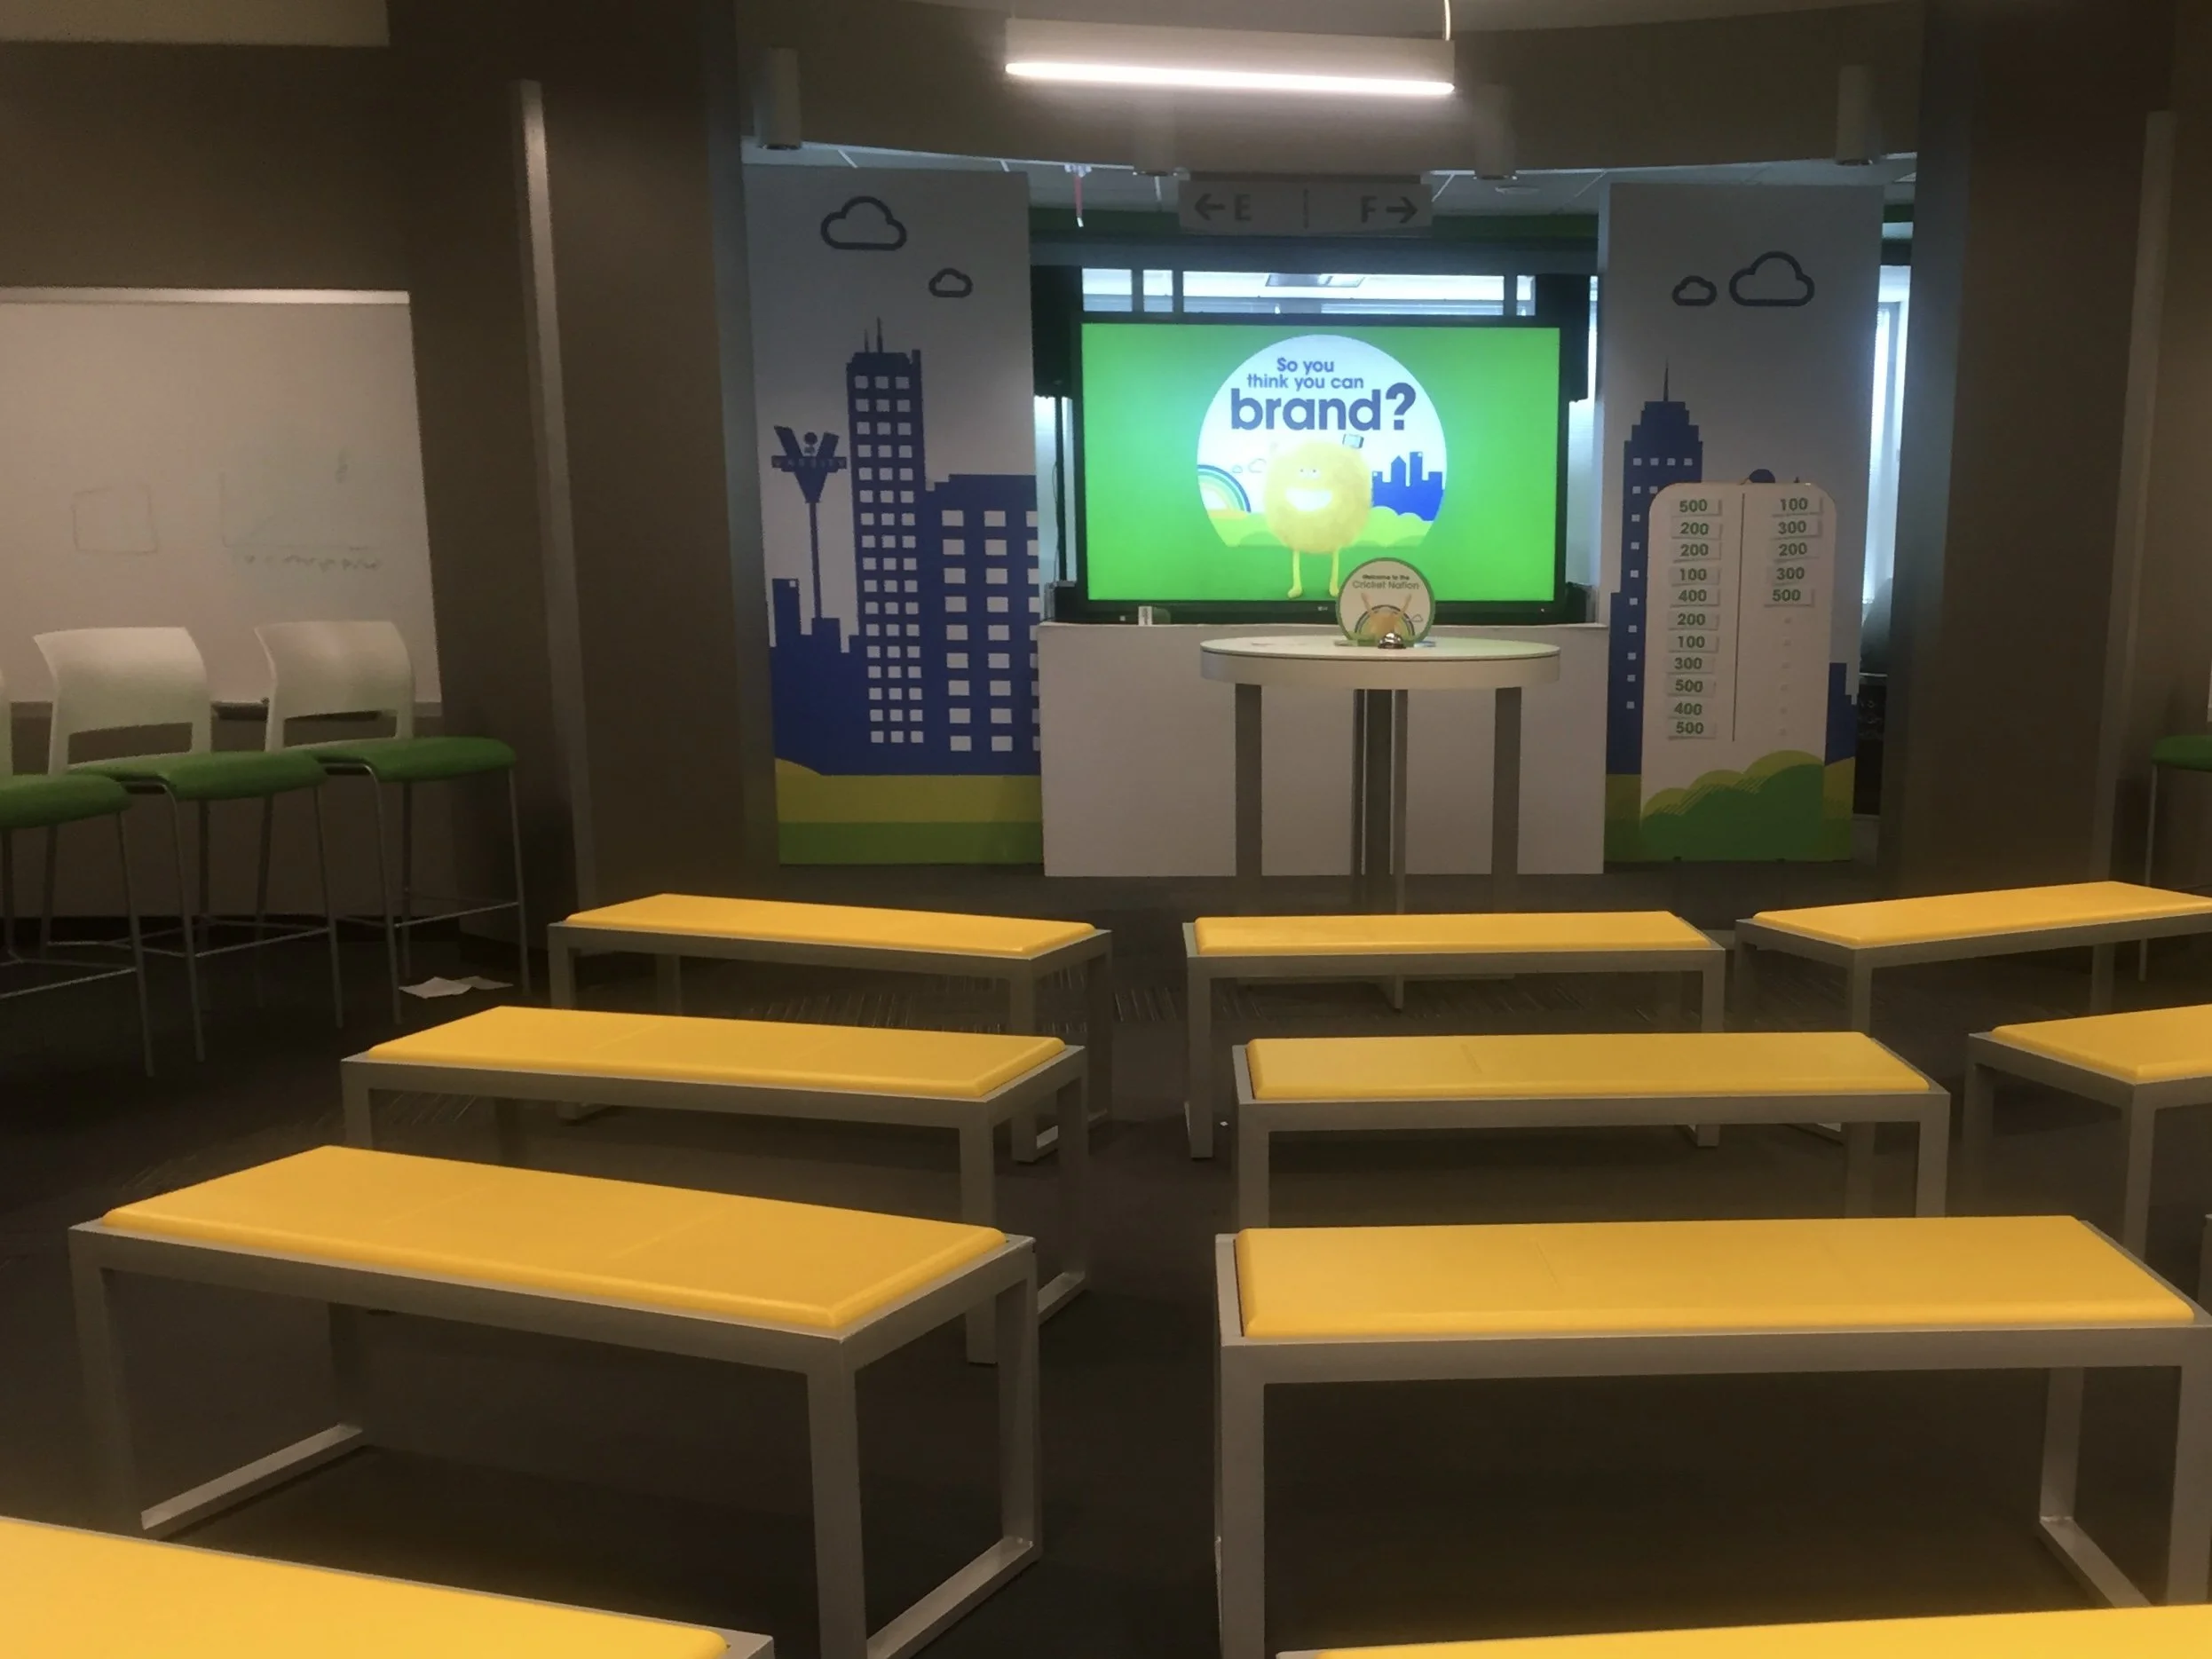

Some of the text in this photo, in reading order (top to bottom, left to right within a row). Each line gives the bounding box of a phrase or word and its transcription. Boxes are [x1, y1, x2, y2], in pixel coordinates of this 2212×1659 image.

[1234, 194, 1252, 222] E
[1360, 195, 1378, 223] F
[1276, 357, 1334, 375] So you
[1247, 374, 1364, 391] think you can
[1230, 382, 1417, 431] brand?
[1679, 499, 1708, 512] 500
[1780, 498, 1808, 510] 100
[1680, 522, 1709, 535] 200
[1778, 521, 1806, 534] 300
[1680, 543, 1709, 557] 200
[1779, 542, 1807, 557] 200
[1679, 568, 1707, 581] 100
[1776, 567, 1805, 580] 300
[1352, 580, 1420, 590] Cricket Nation
[1679, 589, 1707, 602] 400
[1773, 589, 1801, 602] 500
[1678, 613, 1706, 626] 200
[1678, 636, 1705, 648] 100
[1674, 657, 1702, 669] 300
[1675, 679, 1703, 692] 500
[1674, 702, 1702, 715] 400
[1676, 722, 1704, 734] 500
